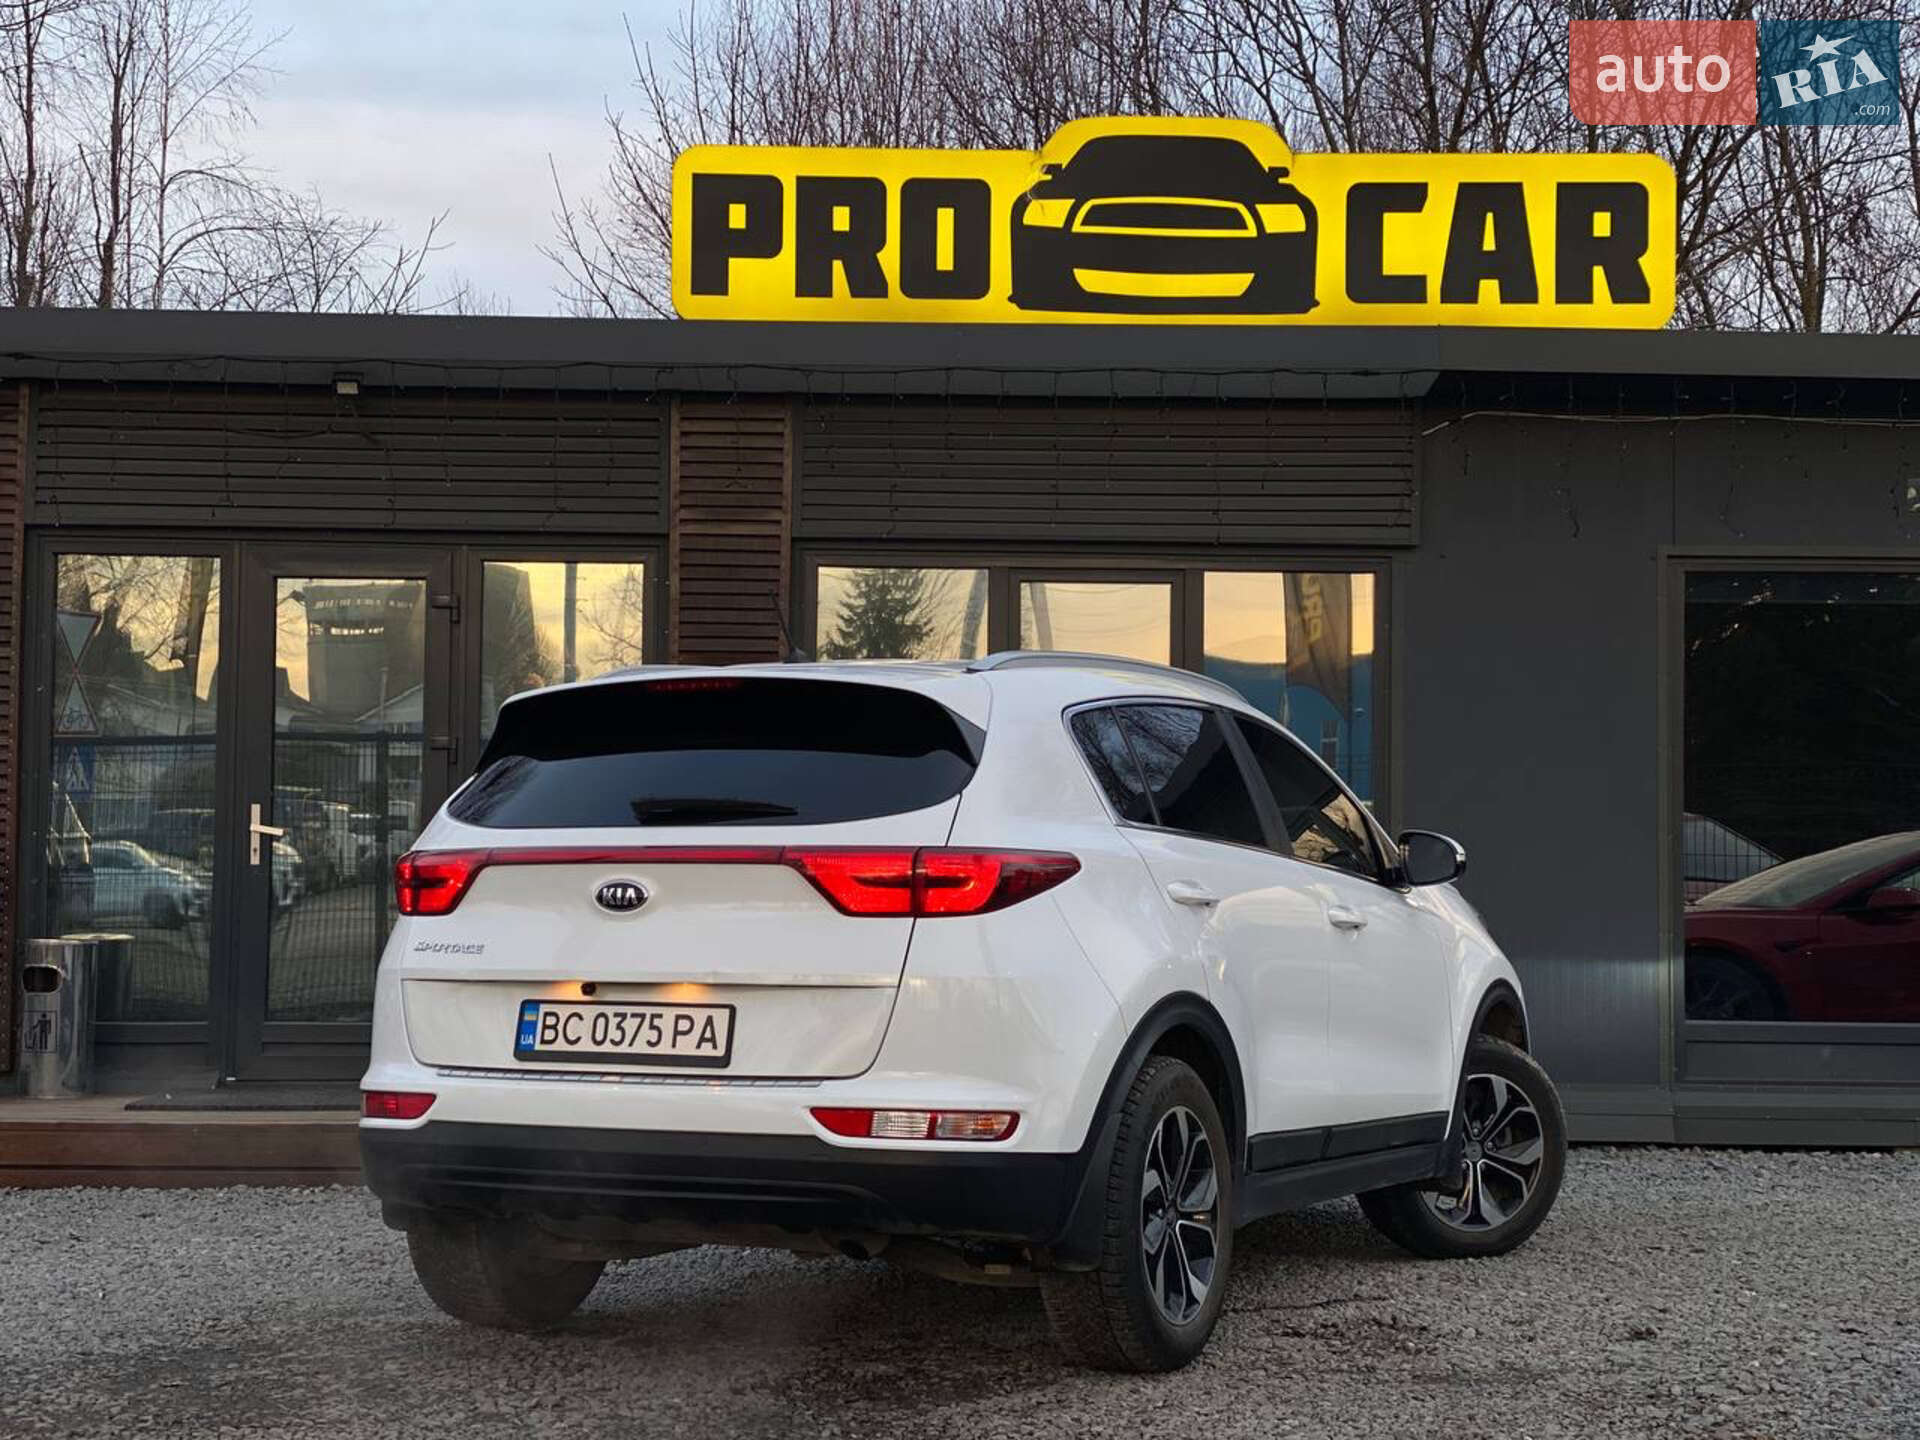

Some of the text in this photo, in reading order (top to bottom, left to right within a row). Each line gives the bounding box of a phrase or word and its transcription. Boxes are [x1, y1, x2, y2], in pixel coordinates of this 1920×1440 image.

[691, 173, 1650, 304] PRO CAR
[602, 887, 638, 906] KIA
[520, 1034, 534, 1045] UA
